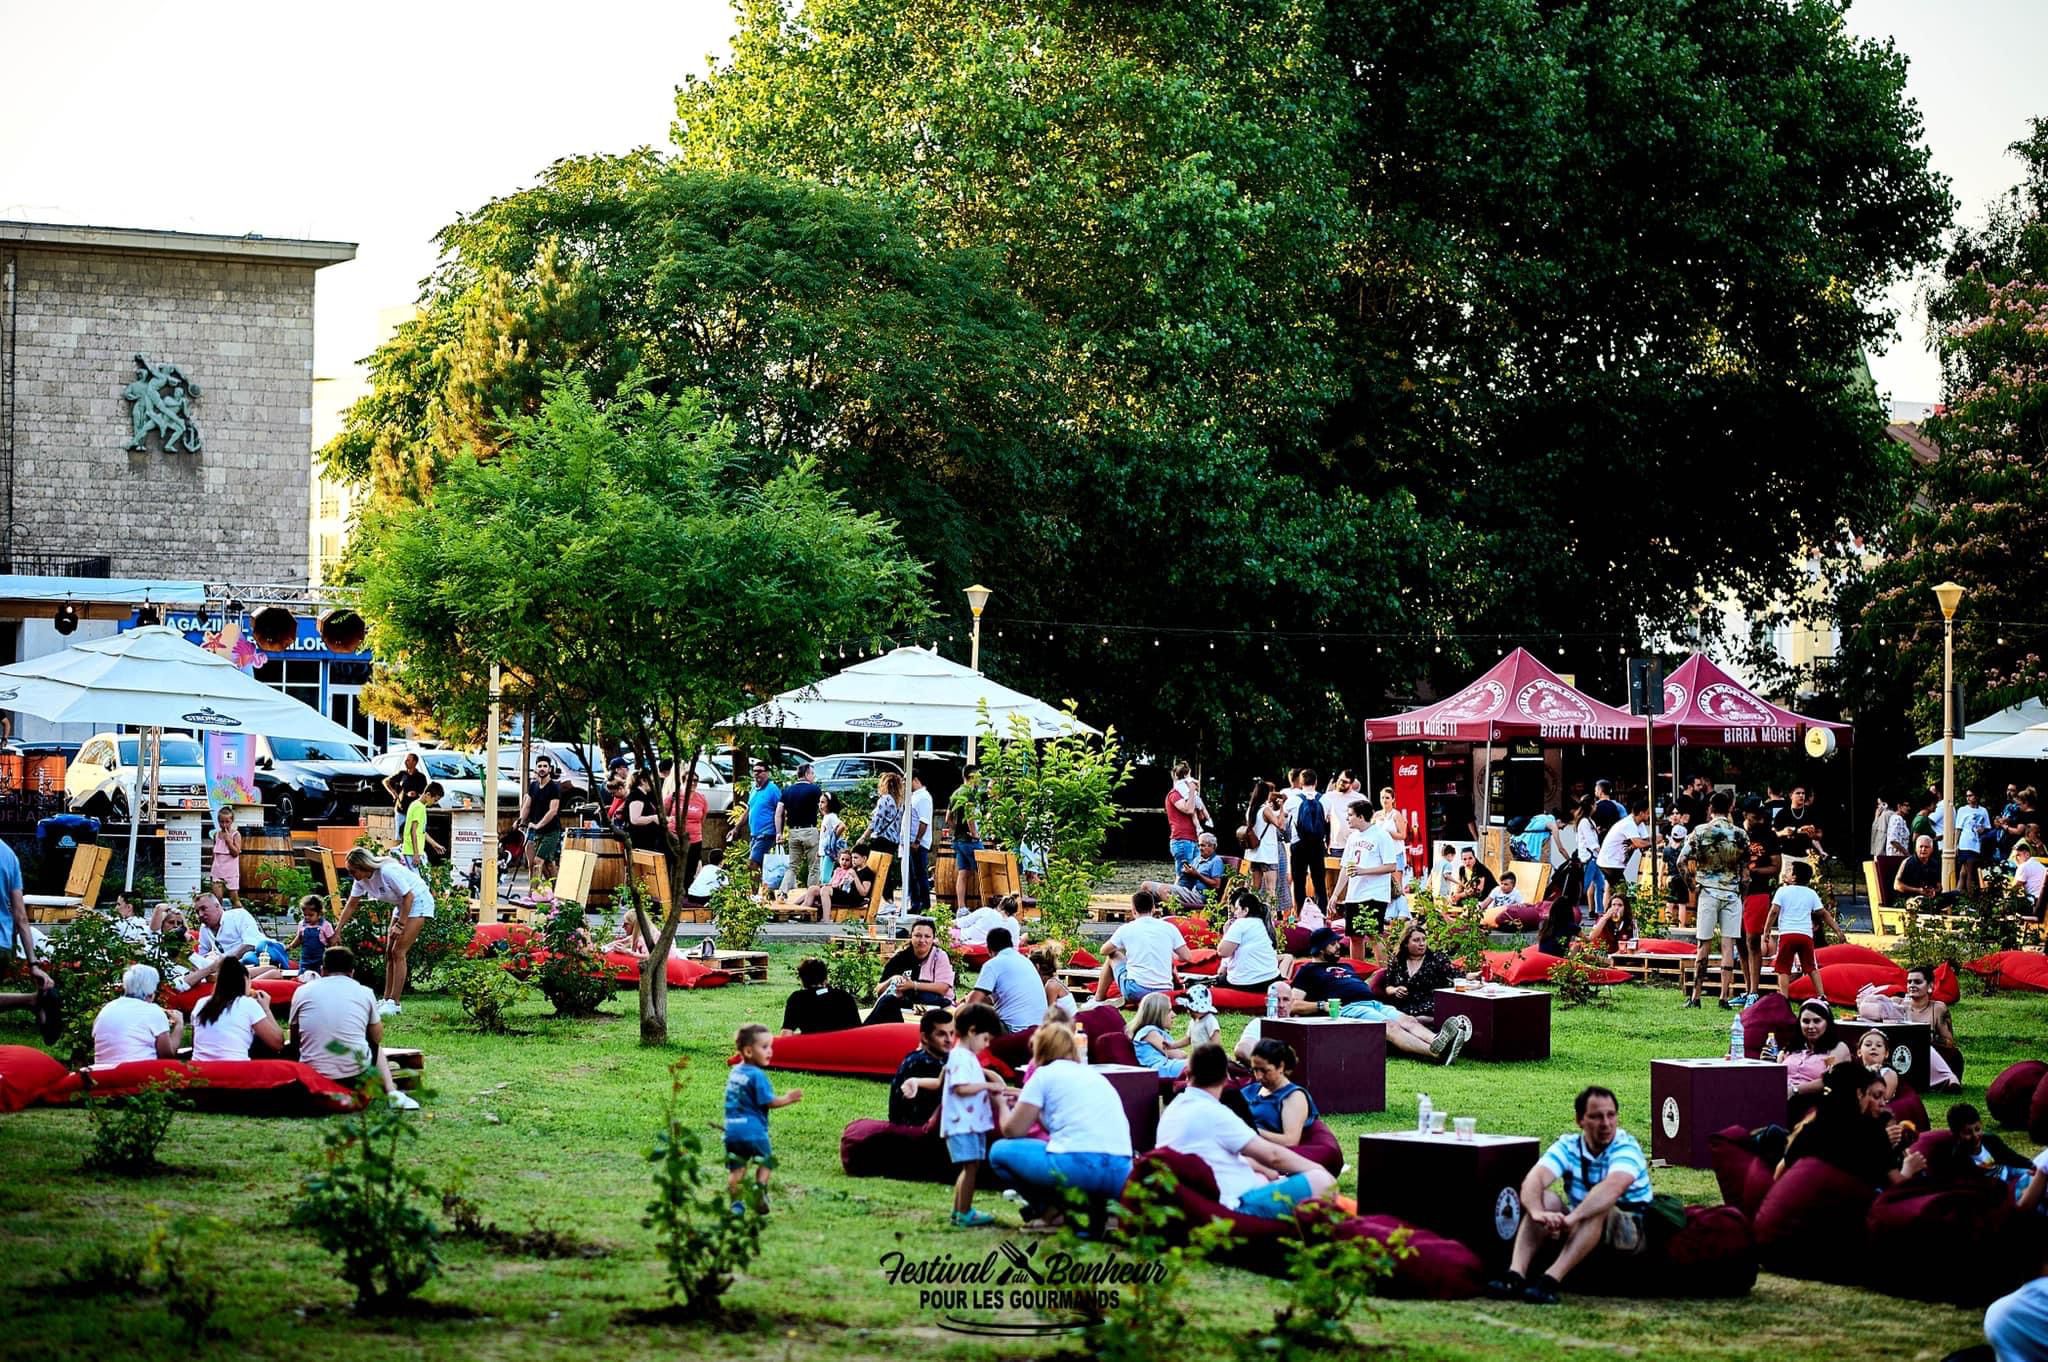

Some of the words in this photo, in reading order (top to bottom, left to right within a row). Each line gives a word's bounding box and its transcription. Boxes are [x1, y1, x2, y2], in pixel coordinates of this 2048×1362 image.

[1397, 719, 1421, 737] BIRRA
[1423, 719, 1458, 737] MORETTI
[1540, 722, 1576, 738] BIRRA
[1580, 724, 1630, 740] MORETTI
[1724, 727, 1758, 743] BIRRA
[1761, 726, 1797, 743] MORET
